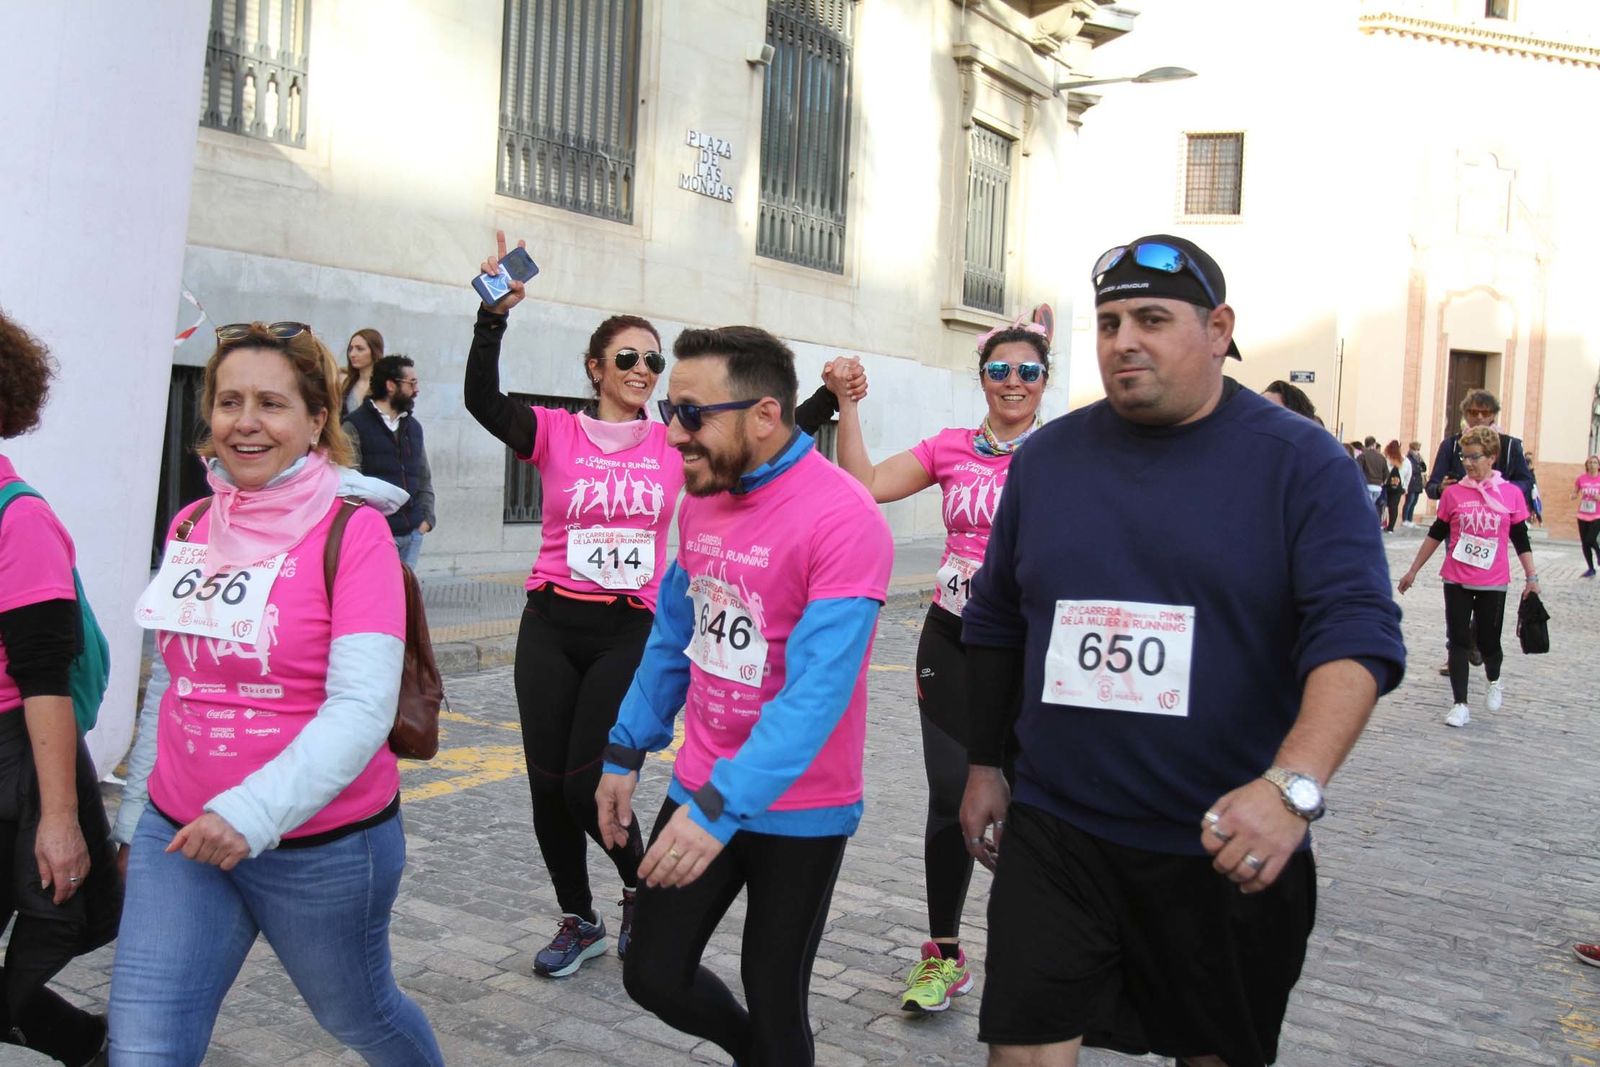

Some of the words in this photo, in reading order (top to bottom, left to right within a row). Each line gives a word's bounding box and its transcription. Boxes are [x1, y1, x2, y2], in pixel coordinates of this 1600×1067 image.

[688, 130, 732, 158] PLAZA
[701, 150, 718, 167] DE
[697, 162, 722, 183] LAS
[680, 173, 734, 202] MONJAS
[585, 531, 614, 539] CARRERA
[697, 533, 722, 547] CARRERA
[750, 544, 771, 557] PINK
[587, 546, 641, 570] 414
[726, 549, 769, 568] RUNNING
[1464, 543, 1490, 559] 623
[172, 568, 252, 605] 656
[1060, 615, 1072, 625] DE
[1073, 616, 1084, 625] LA
[1087, 617, 1120, 627] MUJER
[1132, 619, 1186, 633] RUNNING
[1079, 606, 1121, 616] CARRERA
[1159, 611, 1186, 622] PINK
[700, 602, 753, 650] 646
[1078, 632, 1165, 676] 650
